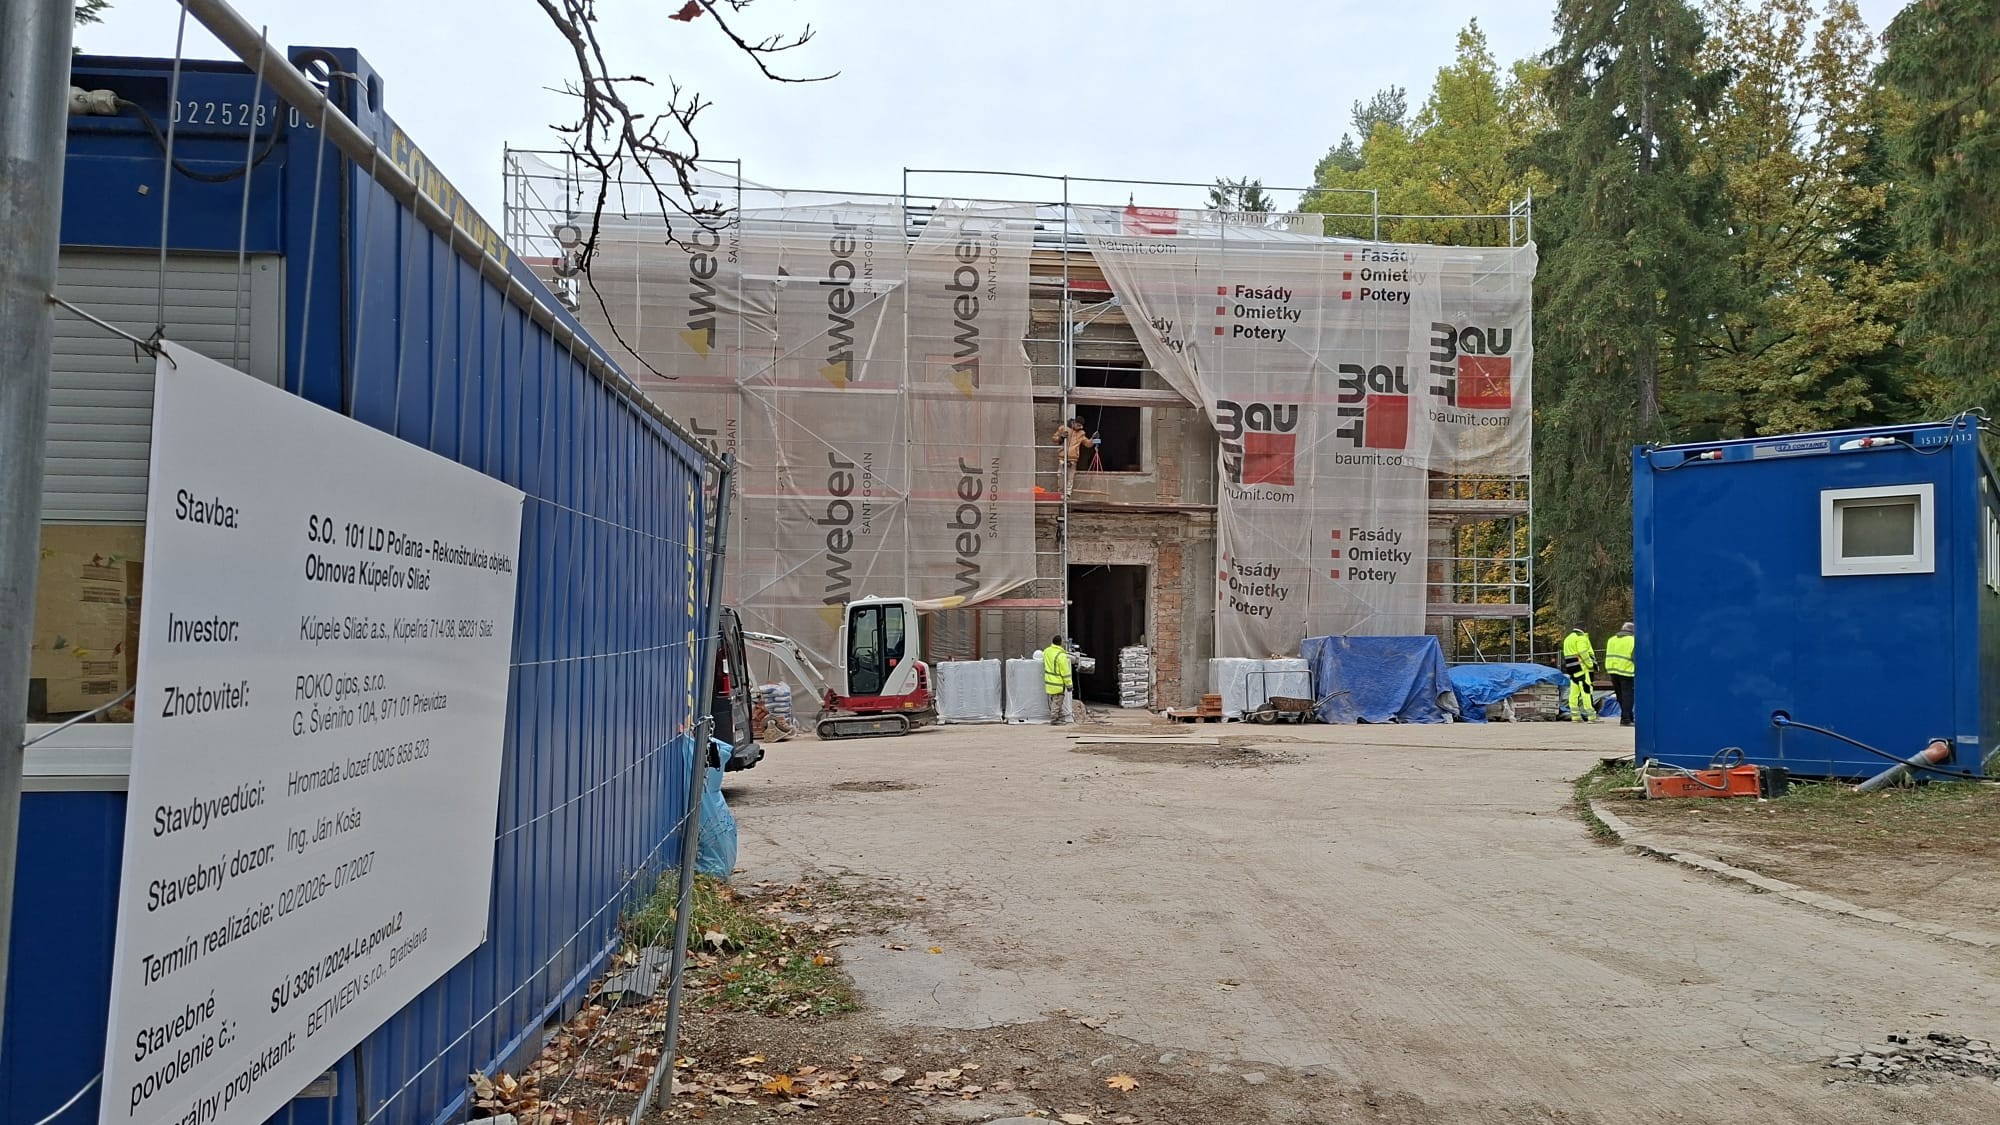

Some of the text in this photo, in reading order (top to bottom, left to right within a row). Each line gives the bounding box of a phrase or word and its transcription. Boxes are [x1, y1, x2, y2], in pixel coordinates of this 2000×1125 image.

[819, 213, 857, 352] weber
[945, 222, 982, 359] weber
[1235, 285, 1292, 303] Fasády
[1360, 288, 1410, 305] Potery
[1233, 324, 1286, 342] Potery
[1234, 304, 1301, 323] Omietky
[1429, 409, 1510, 427] baumit.com
[175, 489, 239, 528] Stavba:
[862, 452, 872, 535] SAINT-GOBAIN
[988, 457, 1000, 539] SAINT-GOBAIN
[307, 514, 336, 544] S.O.
[344, 522, 364, 548] 101
[368, 526, 384, 551] LD
[387, 531, 422, 558] Poľana
[432, 540, 488, 569] Rekonštrukcia
[817, 452, 855, 593] weber
[947, 457, 983, 597] weber
[1349, 527, 1402, 545] Fasády
[305, 553, 430, 592] Obnova Kúpeľov Sliač
[1348, 547, 1412, 565] Omietky
[1348, 567, 1397, 584] Potery
[1229, 577, 1288, 601] Omietky
[1229, 595, 1273, 619] Potery
[168, 613, 239, 643] Investor:
[300, 615, 340, 646] Kúpele
[342, 616, 368, 640] Sliač
[371, 625, 390, 641] a.s.,
[393, 617, 428, 644] Kúpeľná
[430, 619, 456, 640] 714/38,
[162, 680, 249, 718] Zhotoviteľ:
[295, 672, 386, 701] ROKO gips, s.r.o.
[292, 690, 447, 736] G. Švéniho 10A, 971 01 Prievidza
[288, 738, 430, 797] Hromada Jozef 0905 858 523
[153, 780, 265, 838] Stavbyvedúci:
[287, 807, 361, 854] Ing. Ján Koša
[147, 844, 275, 912] Stavebný dozor:
[334, 851, 375, 890] 07/2027
[142, 902, 274, 987] Termín realizácie:
[270, 974, 291, 1014] SÚ
[307, 974, 362, 1038] BETWEEN
[389, 927, 428, 970] Bratislava
[134, 989, 215, 1063] Stavebné
[130, 1019, 237, 1117] povolenie č.:
[223, 1031, 296, 1112] projektant:
